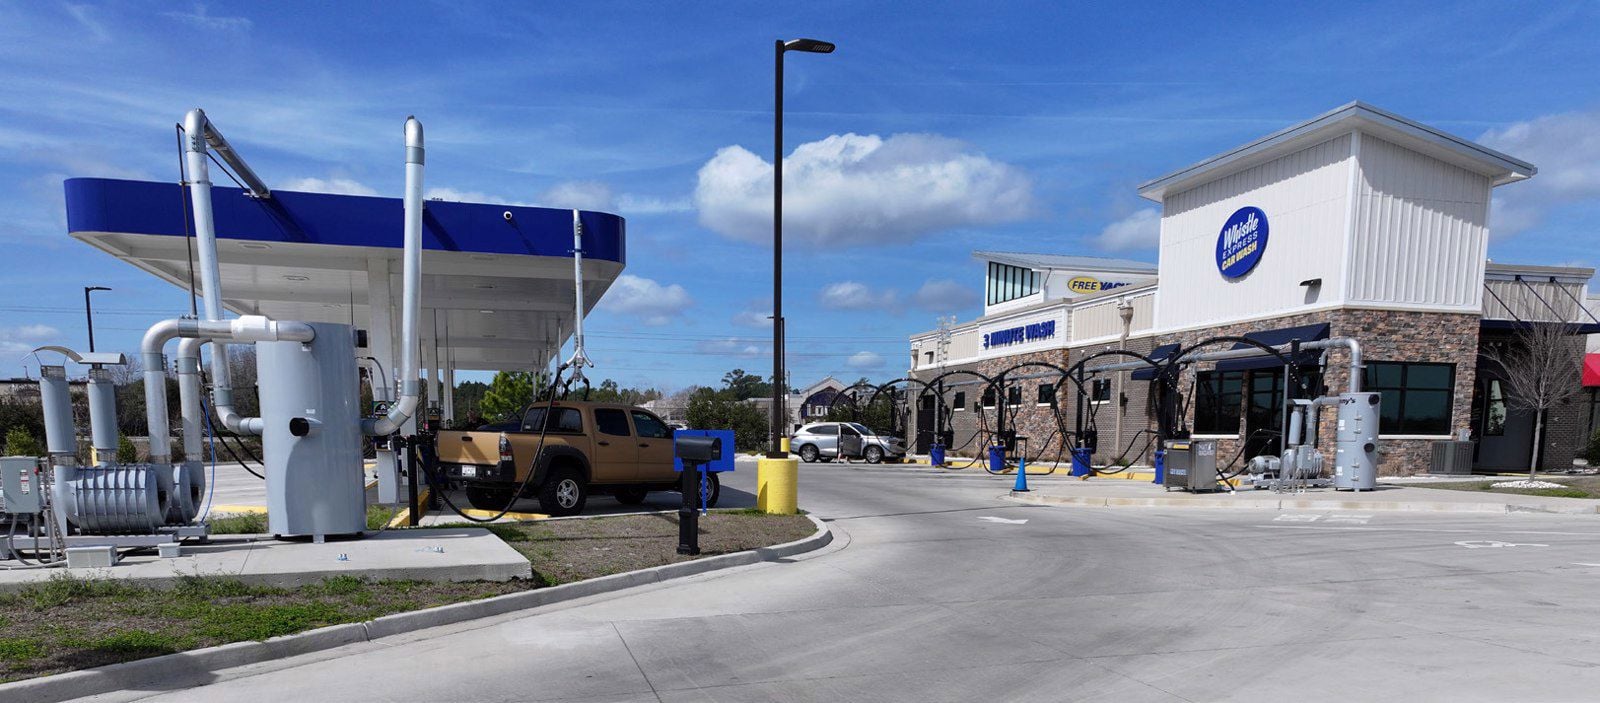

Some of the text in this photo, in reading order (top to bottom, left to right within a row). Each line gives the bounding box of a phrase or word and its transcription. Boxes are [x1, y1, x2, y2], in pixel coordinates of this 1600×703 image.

[1222, 231, 1258, 260] EXPRESS
[1224, 213, 1258, 250] Whistle
[1221, 240, 1257, 270] CAR WASH
[1072, 280, 1098, 290] FREE
[983, 319, 1056, 349] 3 MINUTE WASH!
